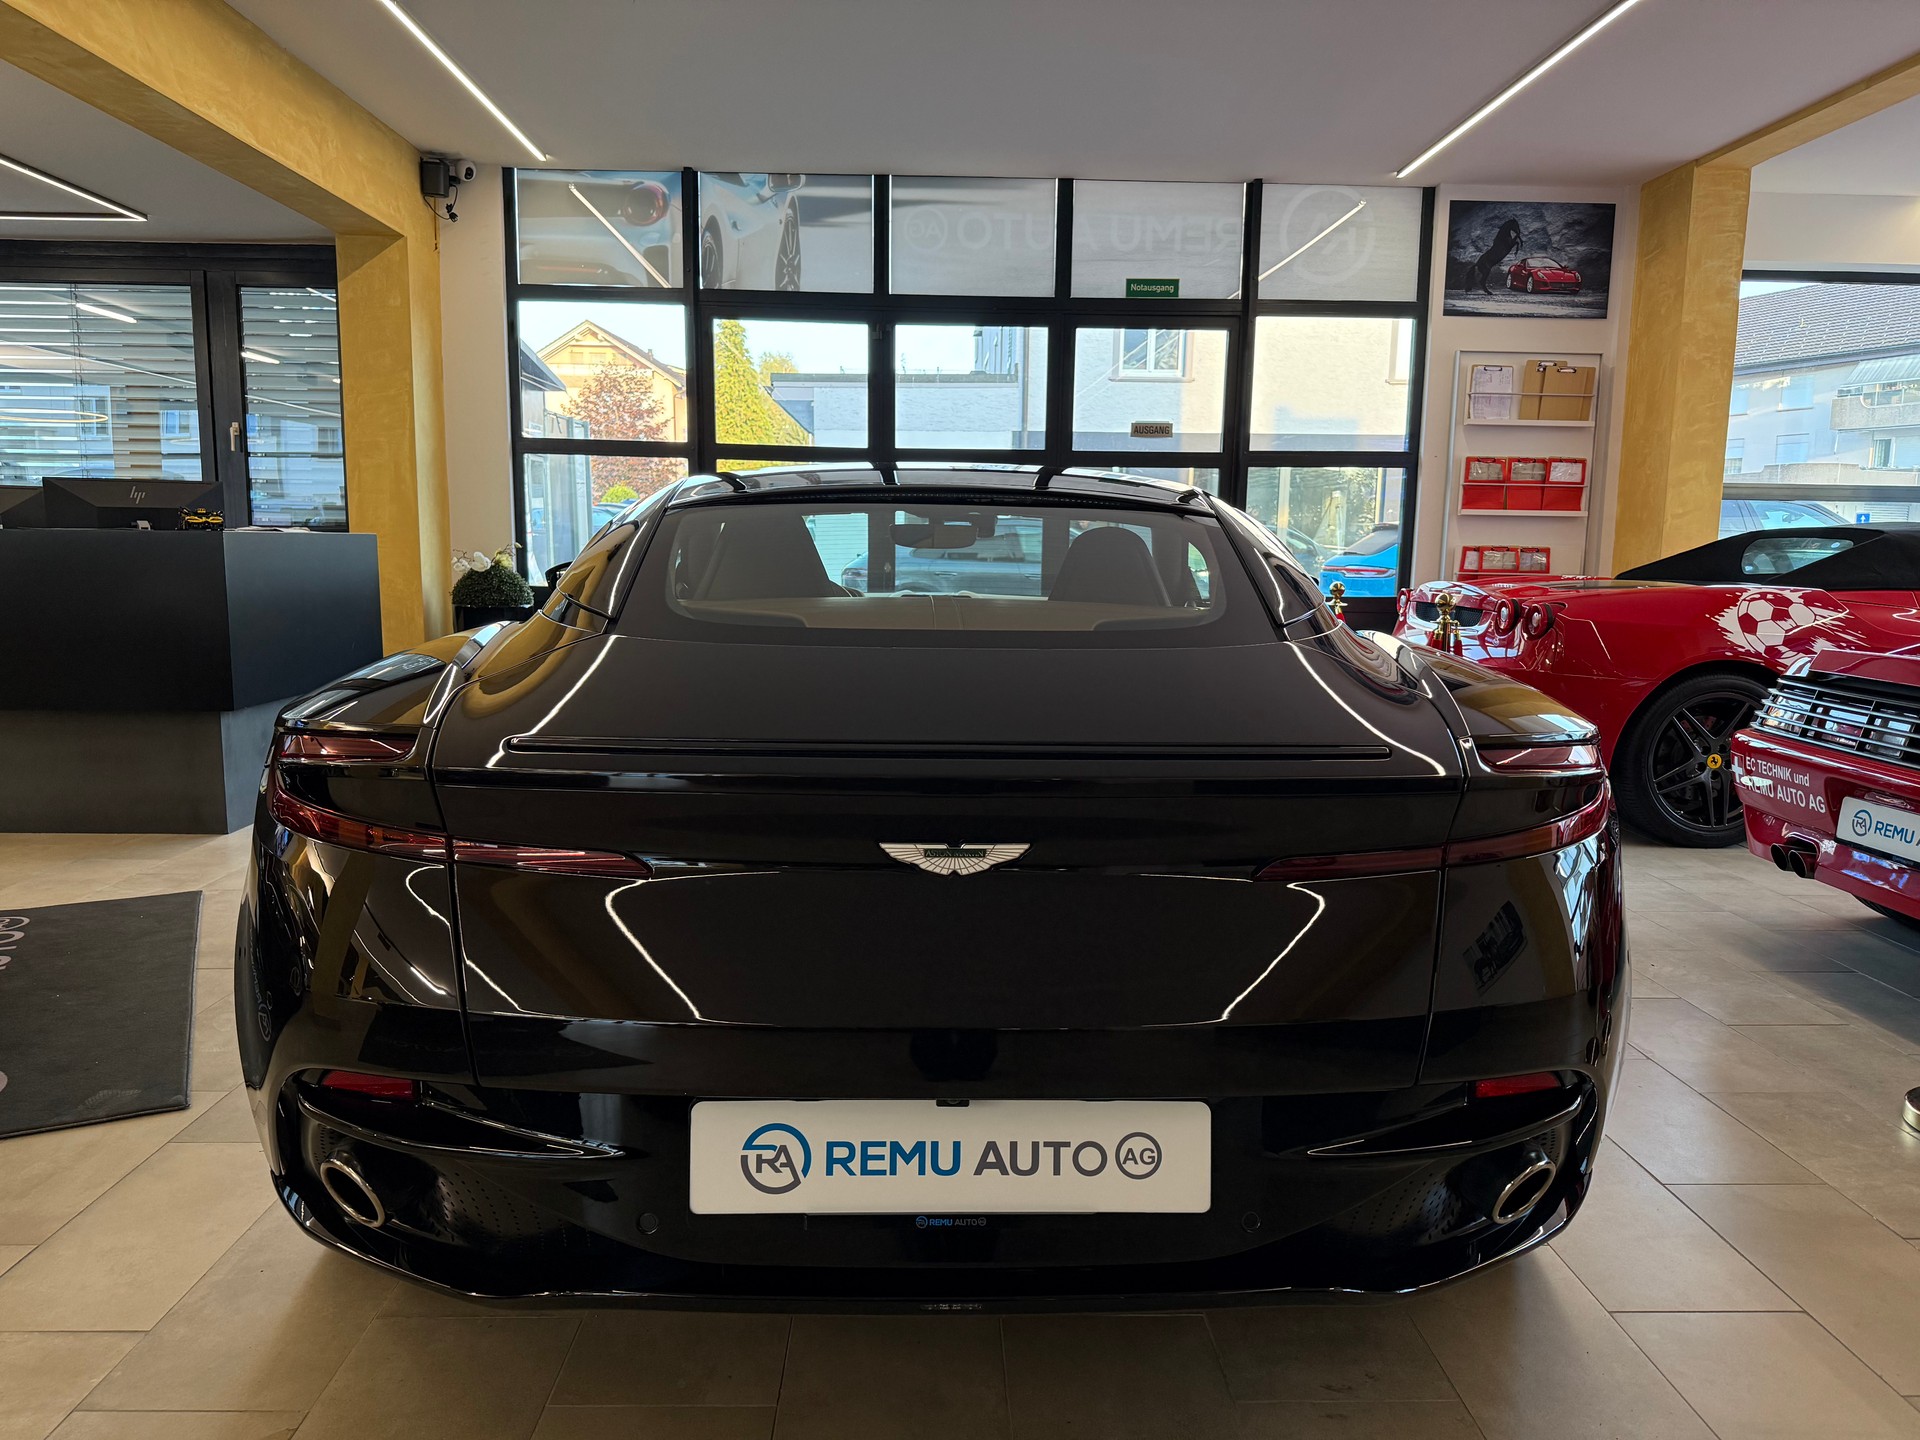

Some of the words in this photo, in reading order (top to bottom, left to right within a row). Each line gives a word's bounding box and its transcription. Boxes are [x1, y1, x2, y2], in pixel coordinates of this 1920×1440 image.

[1130, 283, 1174, 293] Notausgang
[1133, 425, 1170, 434] AUSGANG
[1745, 756, 1756, 771] EC
[1757, 760, 1792, 782] TECHNIK
[1793, 772, 1810, 787] und
[1777, 784, 1806, 808] AUTO
[1809, 793, 1826, 813] AG
[1873, 820, 1916, 844] REMU
[825, 1141, 961, 1176] REMU
[973, 1140, 1108, 1177] AUTO
[929, 1218, 953, 1226] REMU
[954, 1218, 977, 1226] AUTO
